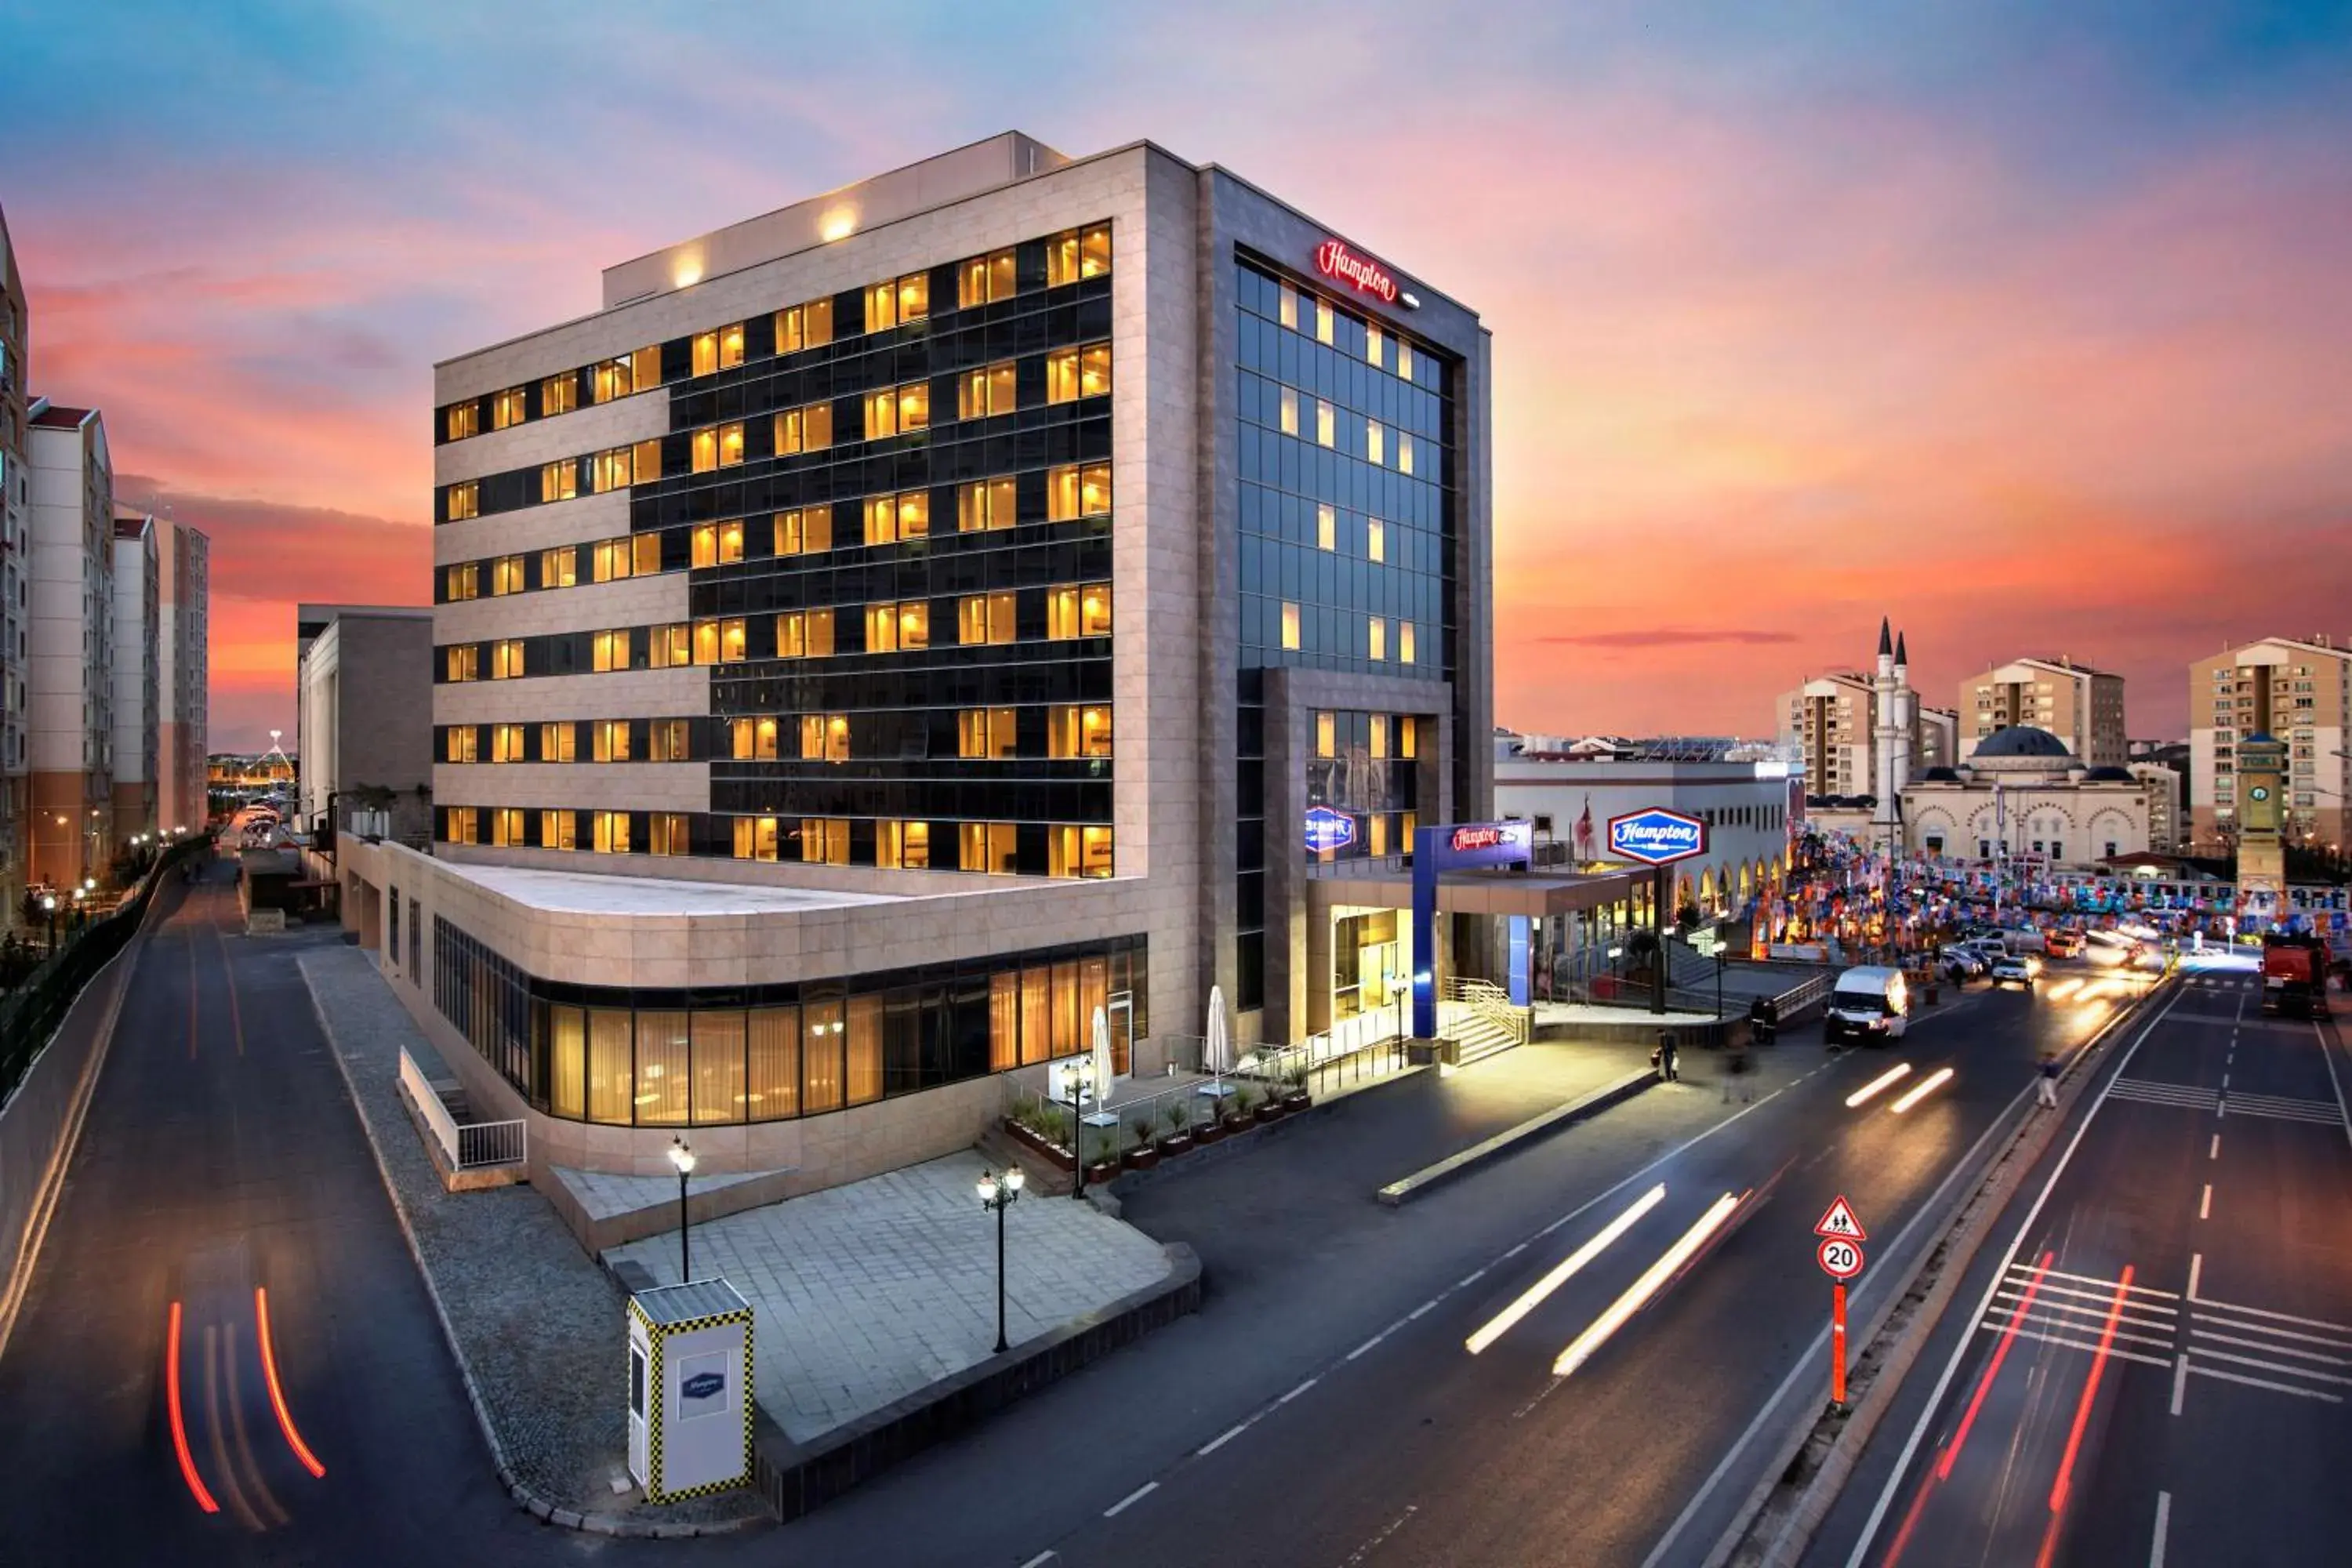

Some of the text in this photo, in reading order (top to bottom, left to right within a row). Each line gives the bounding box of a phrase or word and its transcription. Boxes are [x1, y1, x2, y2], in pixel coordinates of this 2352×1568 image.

[1319, 241, 1396, 301] Hampton
[1453, 828, 1498, 851] Hampton
[1615, 822, 1697, 843] Hampton
[1828, 1246, 1853, 1267] 20
